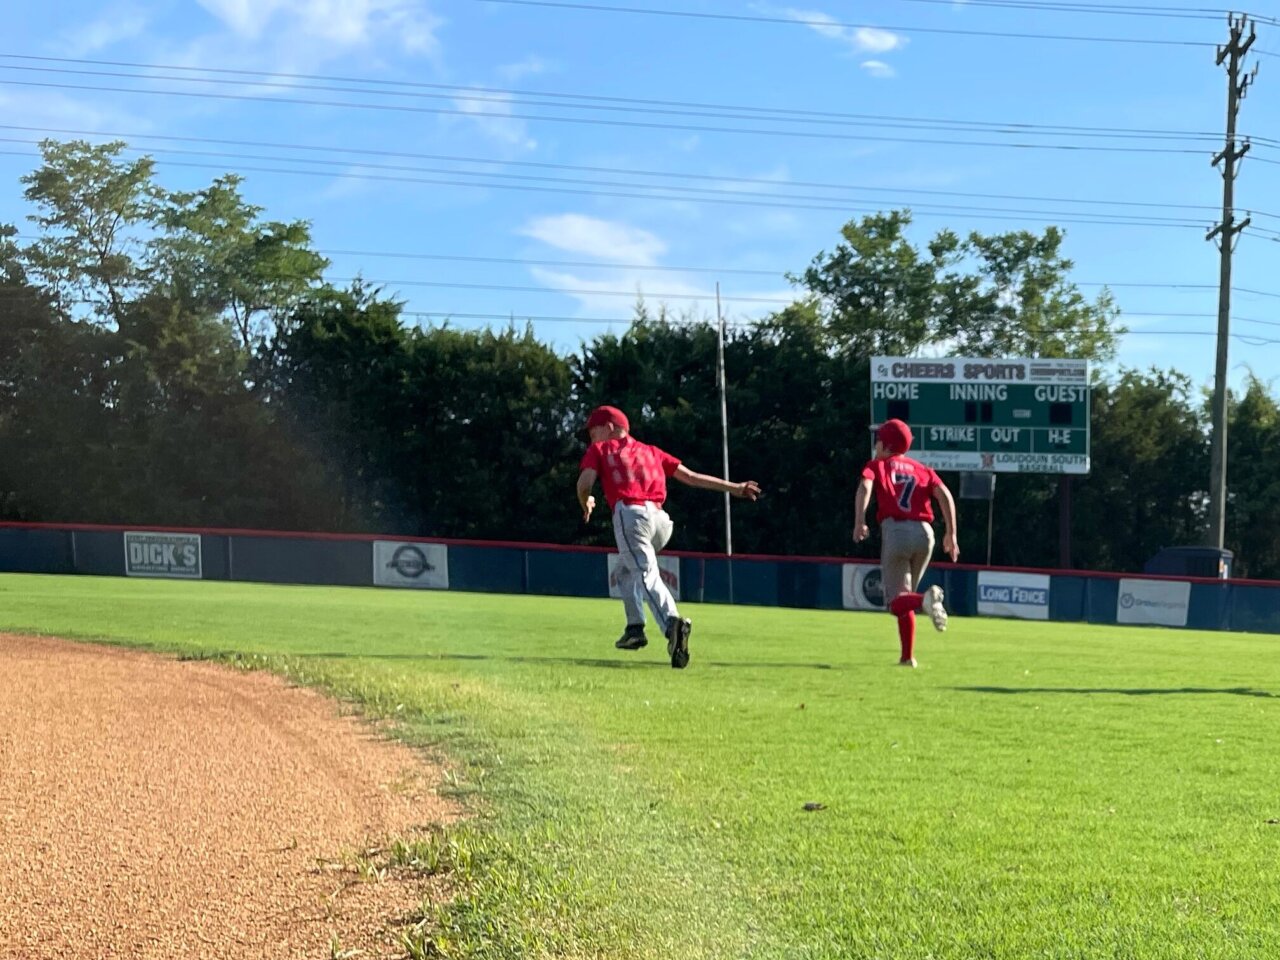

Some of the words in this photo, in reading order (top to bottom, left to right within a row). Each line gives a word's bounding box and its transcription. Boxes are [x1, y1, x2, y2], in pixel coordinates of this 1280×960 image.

[892, 362, 955, 379] CHEERS
[963, 363, 1026, 380] SPORTS
[873, 383, 919, 400] HOME
[950, 384, 1008, 401] INNING
[1034, 385, 1086, 402] GUEST
[930, 427, 975, 442] STRIKE
[991, 428, 1021, 443] OUT
[996, 453, 1048, 464] LOUDOUN
[1051, 455, 1087, 465] SOUTH
[1018, 464, 1064, 472] BASEBALL
[891, 469, 917, 512] 7
[130, 543, 196, 567] DICK'S
[1011, 588, 1046, 604] FENCE
